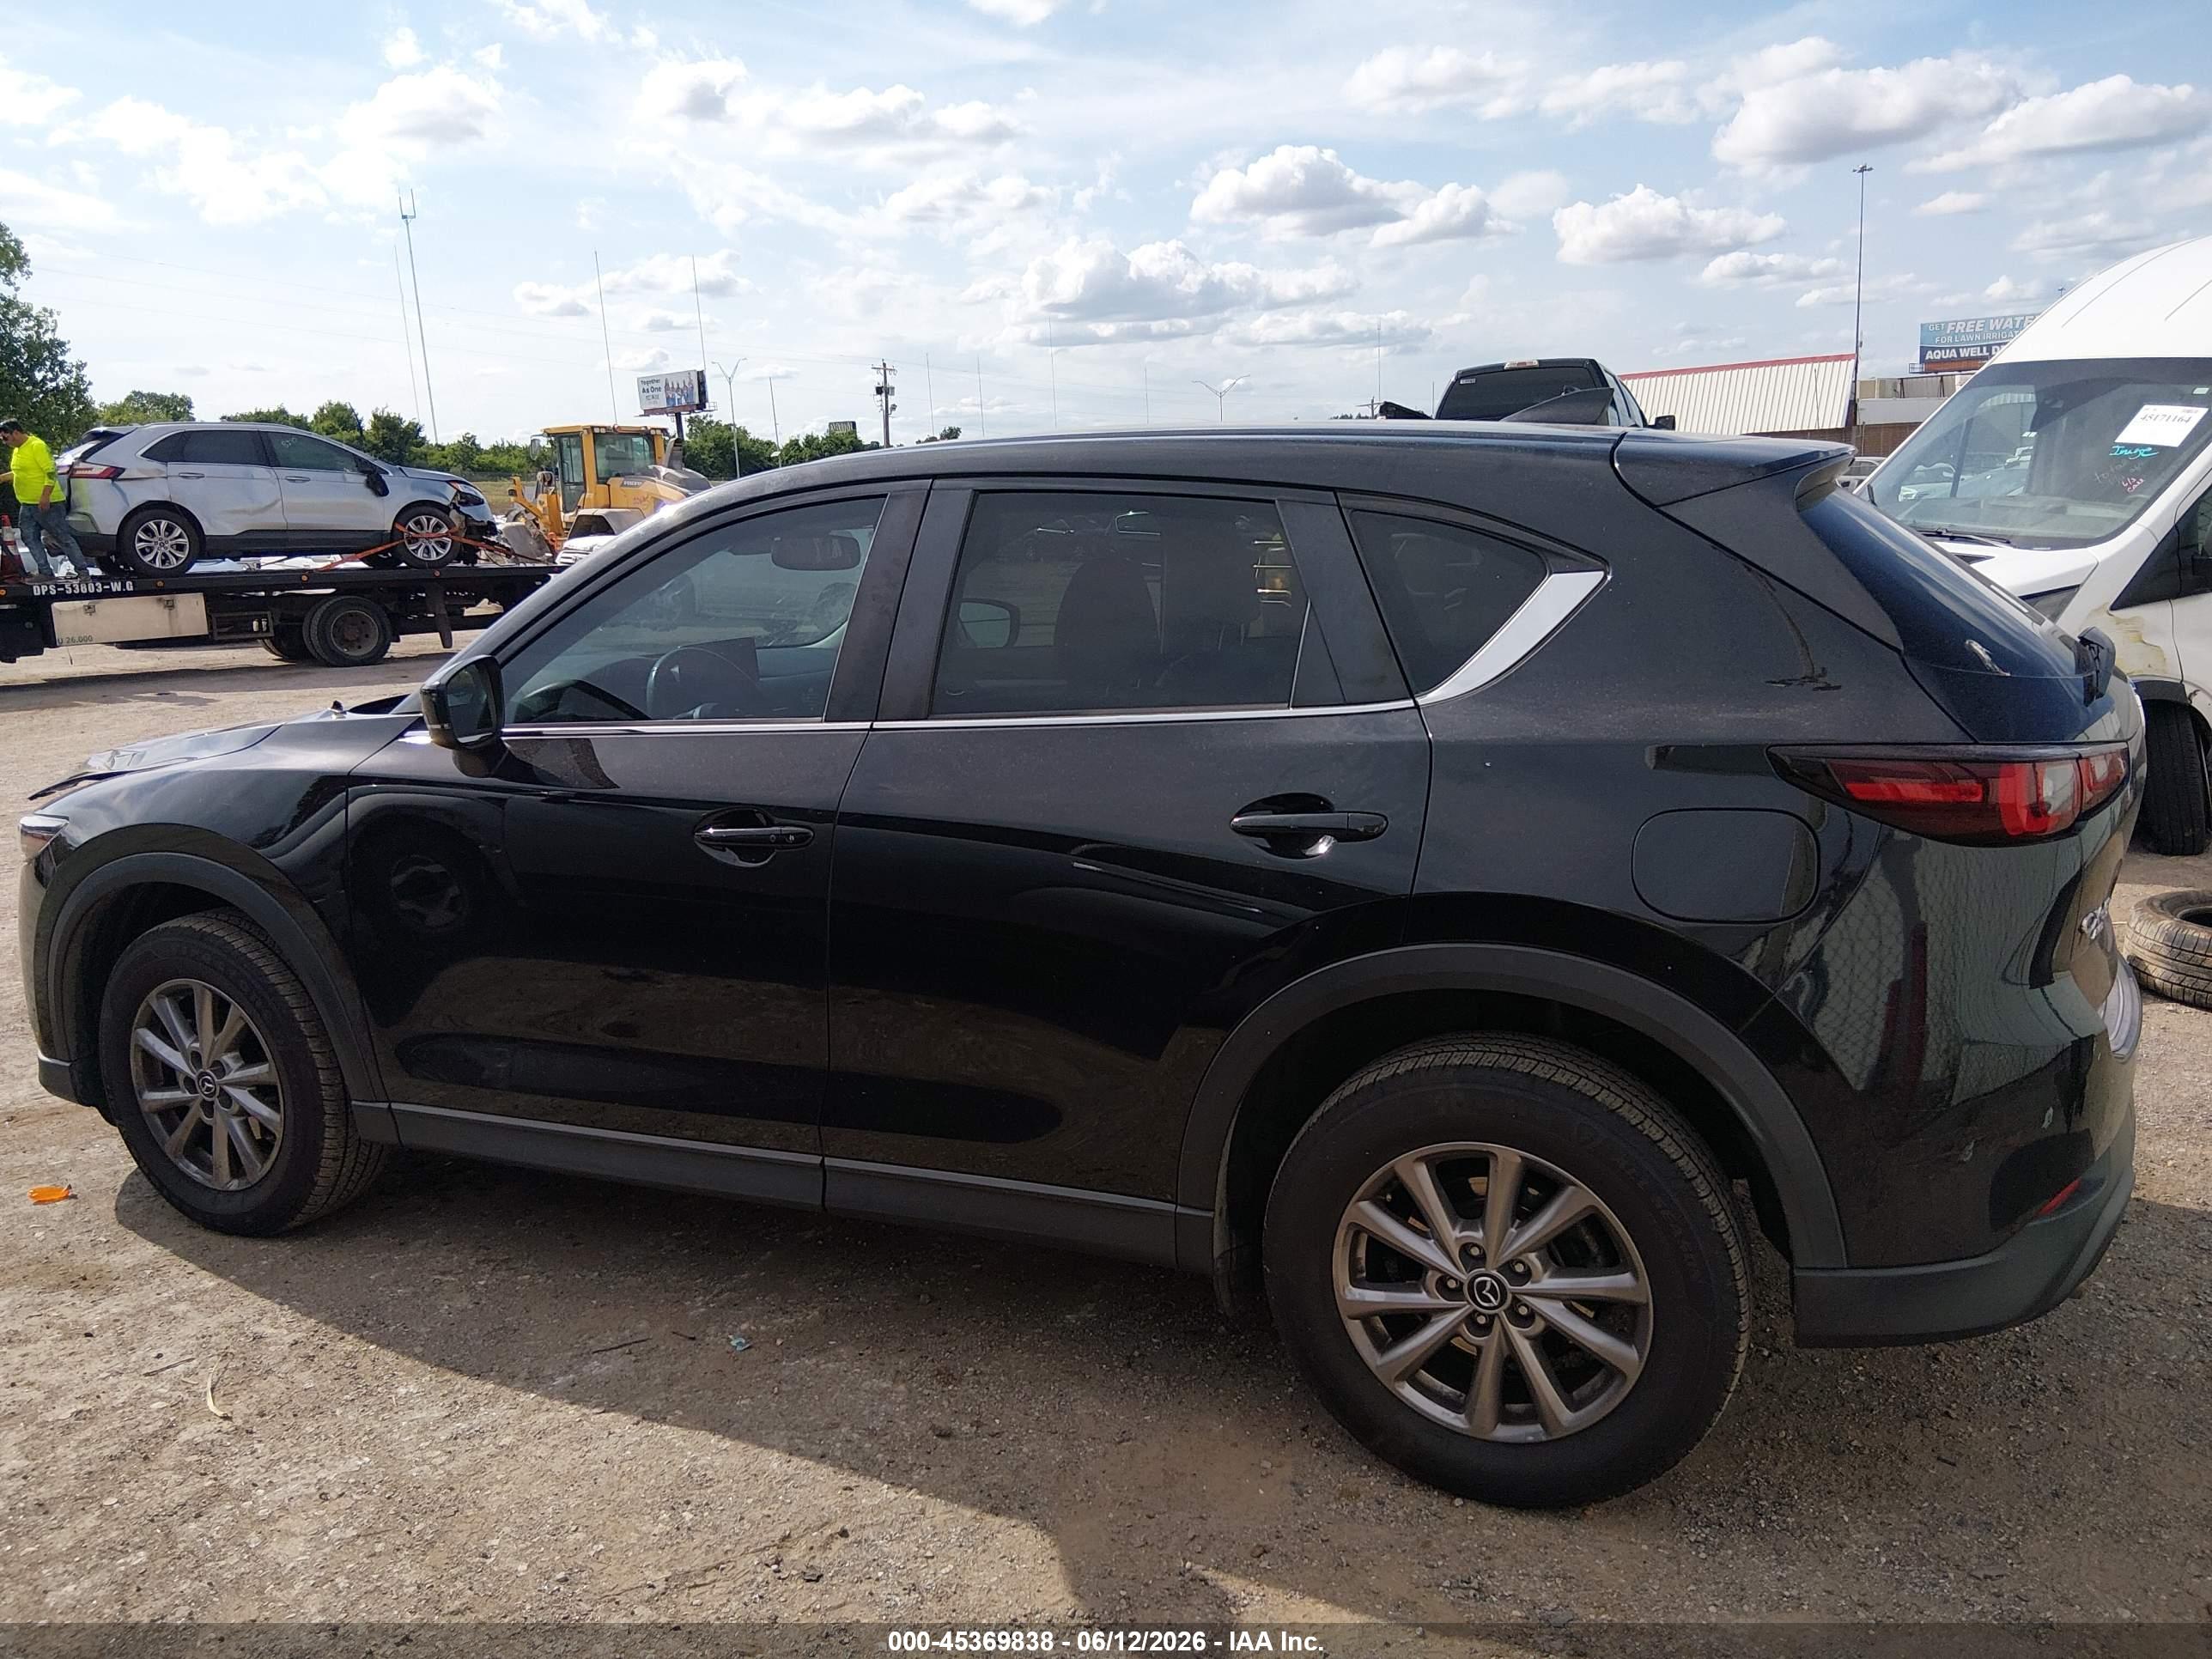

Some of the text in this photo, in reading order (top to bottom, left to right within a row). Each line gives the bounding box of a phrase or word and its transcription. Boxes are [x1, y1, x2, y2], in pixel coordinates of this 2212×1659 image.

[1929, 316, 2036, 333] GET FREE WATE
[1954, 333, 1981, 343] LAWN
[1925, 349, 1958, 360] AQUA
[1960, 346, 1990, 358] WELL
